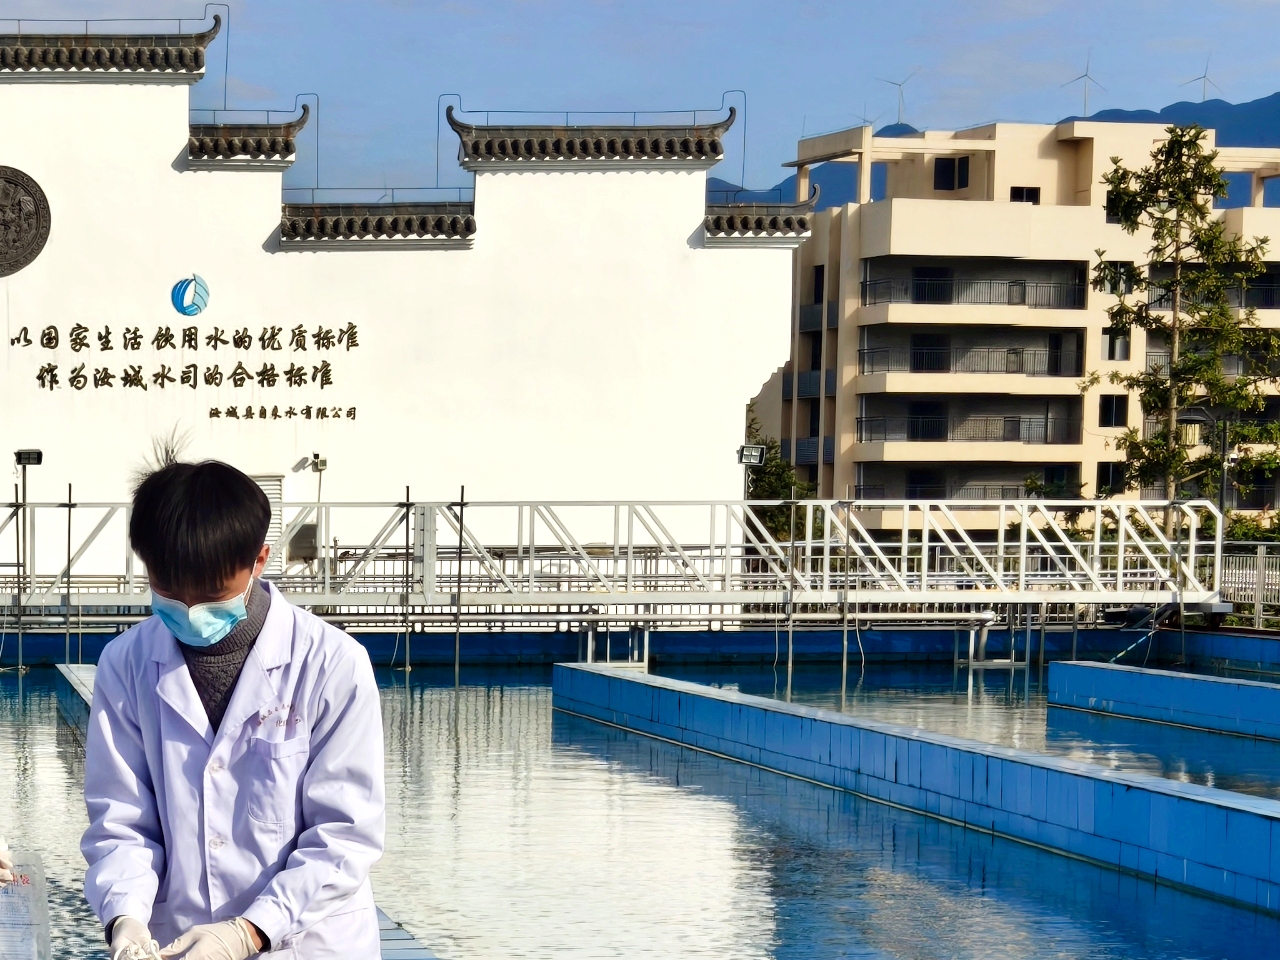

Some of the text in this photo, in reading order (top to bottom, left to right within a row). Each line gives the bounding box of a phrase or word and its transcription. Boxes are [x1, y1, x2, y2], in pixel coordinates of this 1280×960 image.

[10, 322, 360, 352] 以国家生活饮用水的优质标准
[36, 360, 333, 391] 作为汝城水司的合格标准
[209, 405, 356, 420] 汝城县自来水有限公司
